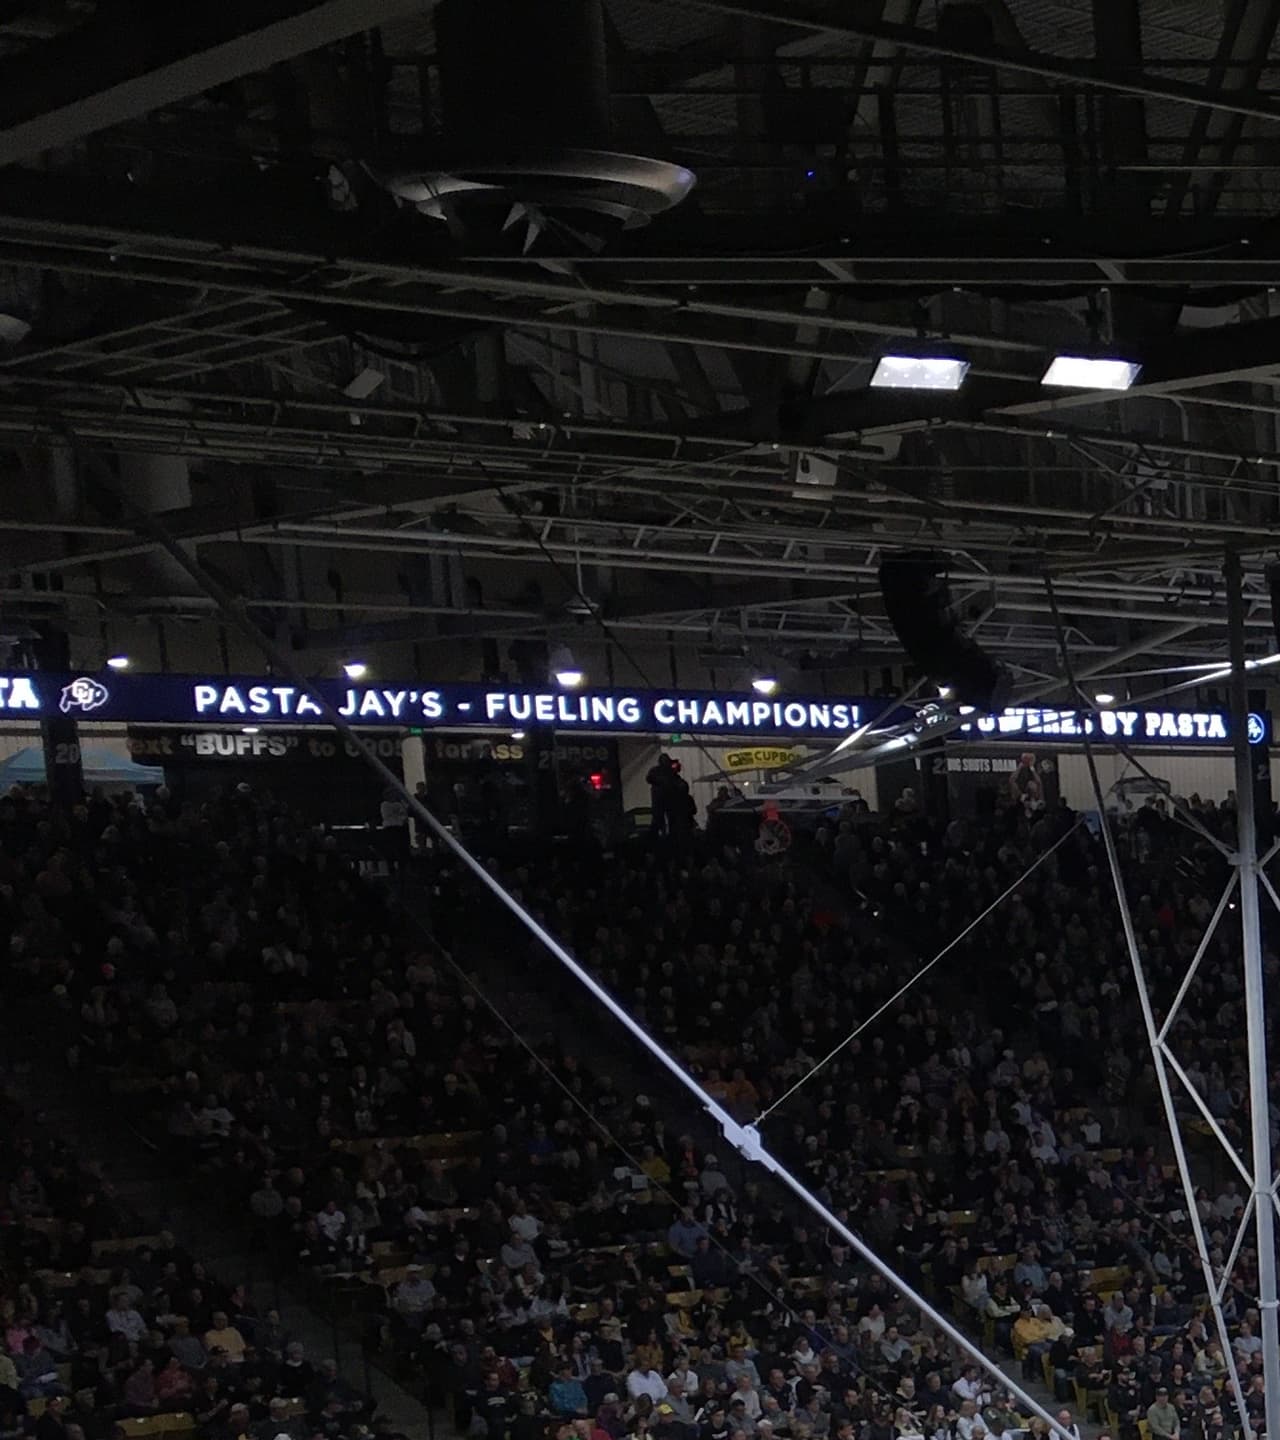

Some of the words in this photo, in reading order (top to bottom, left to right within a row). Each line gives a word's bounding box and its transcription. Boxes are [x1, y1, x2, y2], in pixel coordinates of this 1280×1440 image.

[193, 685, 322, 715] PASTA
[338, 688, 443, 718] JAY'S
[485, 693, 641, 723] FUELING
[654, 698, 861, 729] CHAMPIONS!
[1100, 711, 1138, 736] BY
[1145, 712, 1227, 738] PASTA
